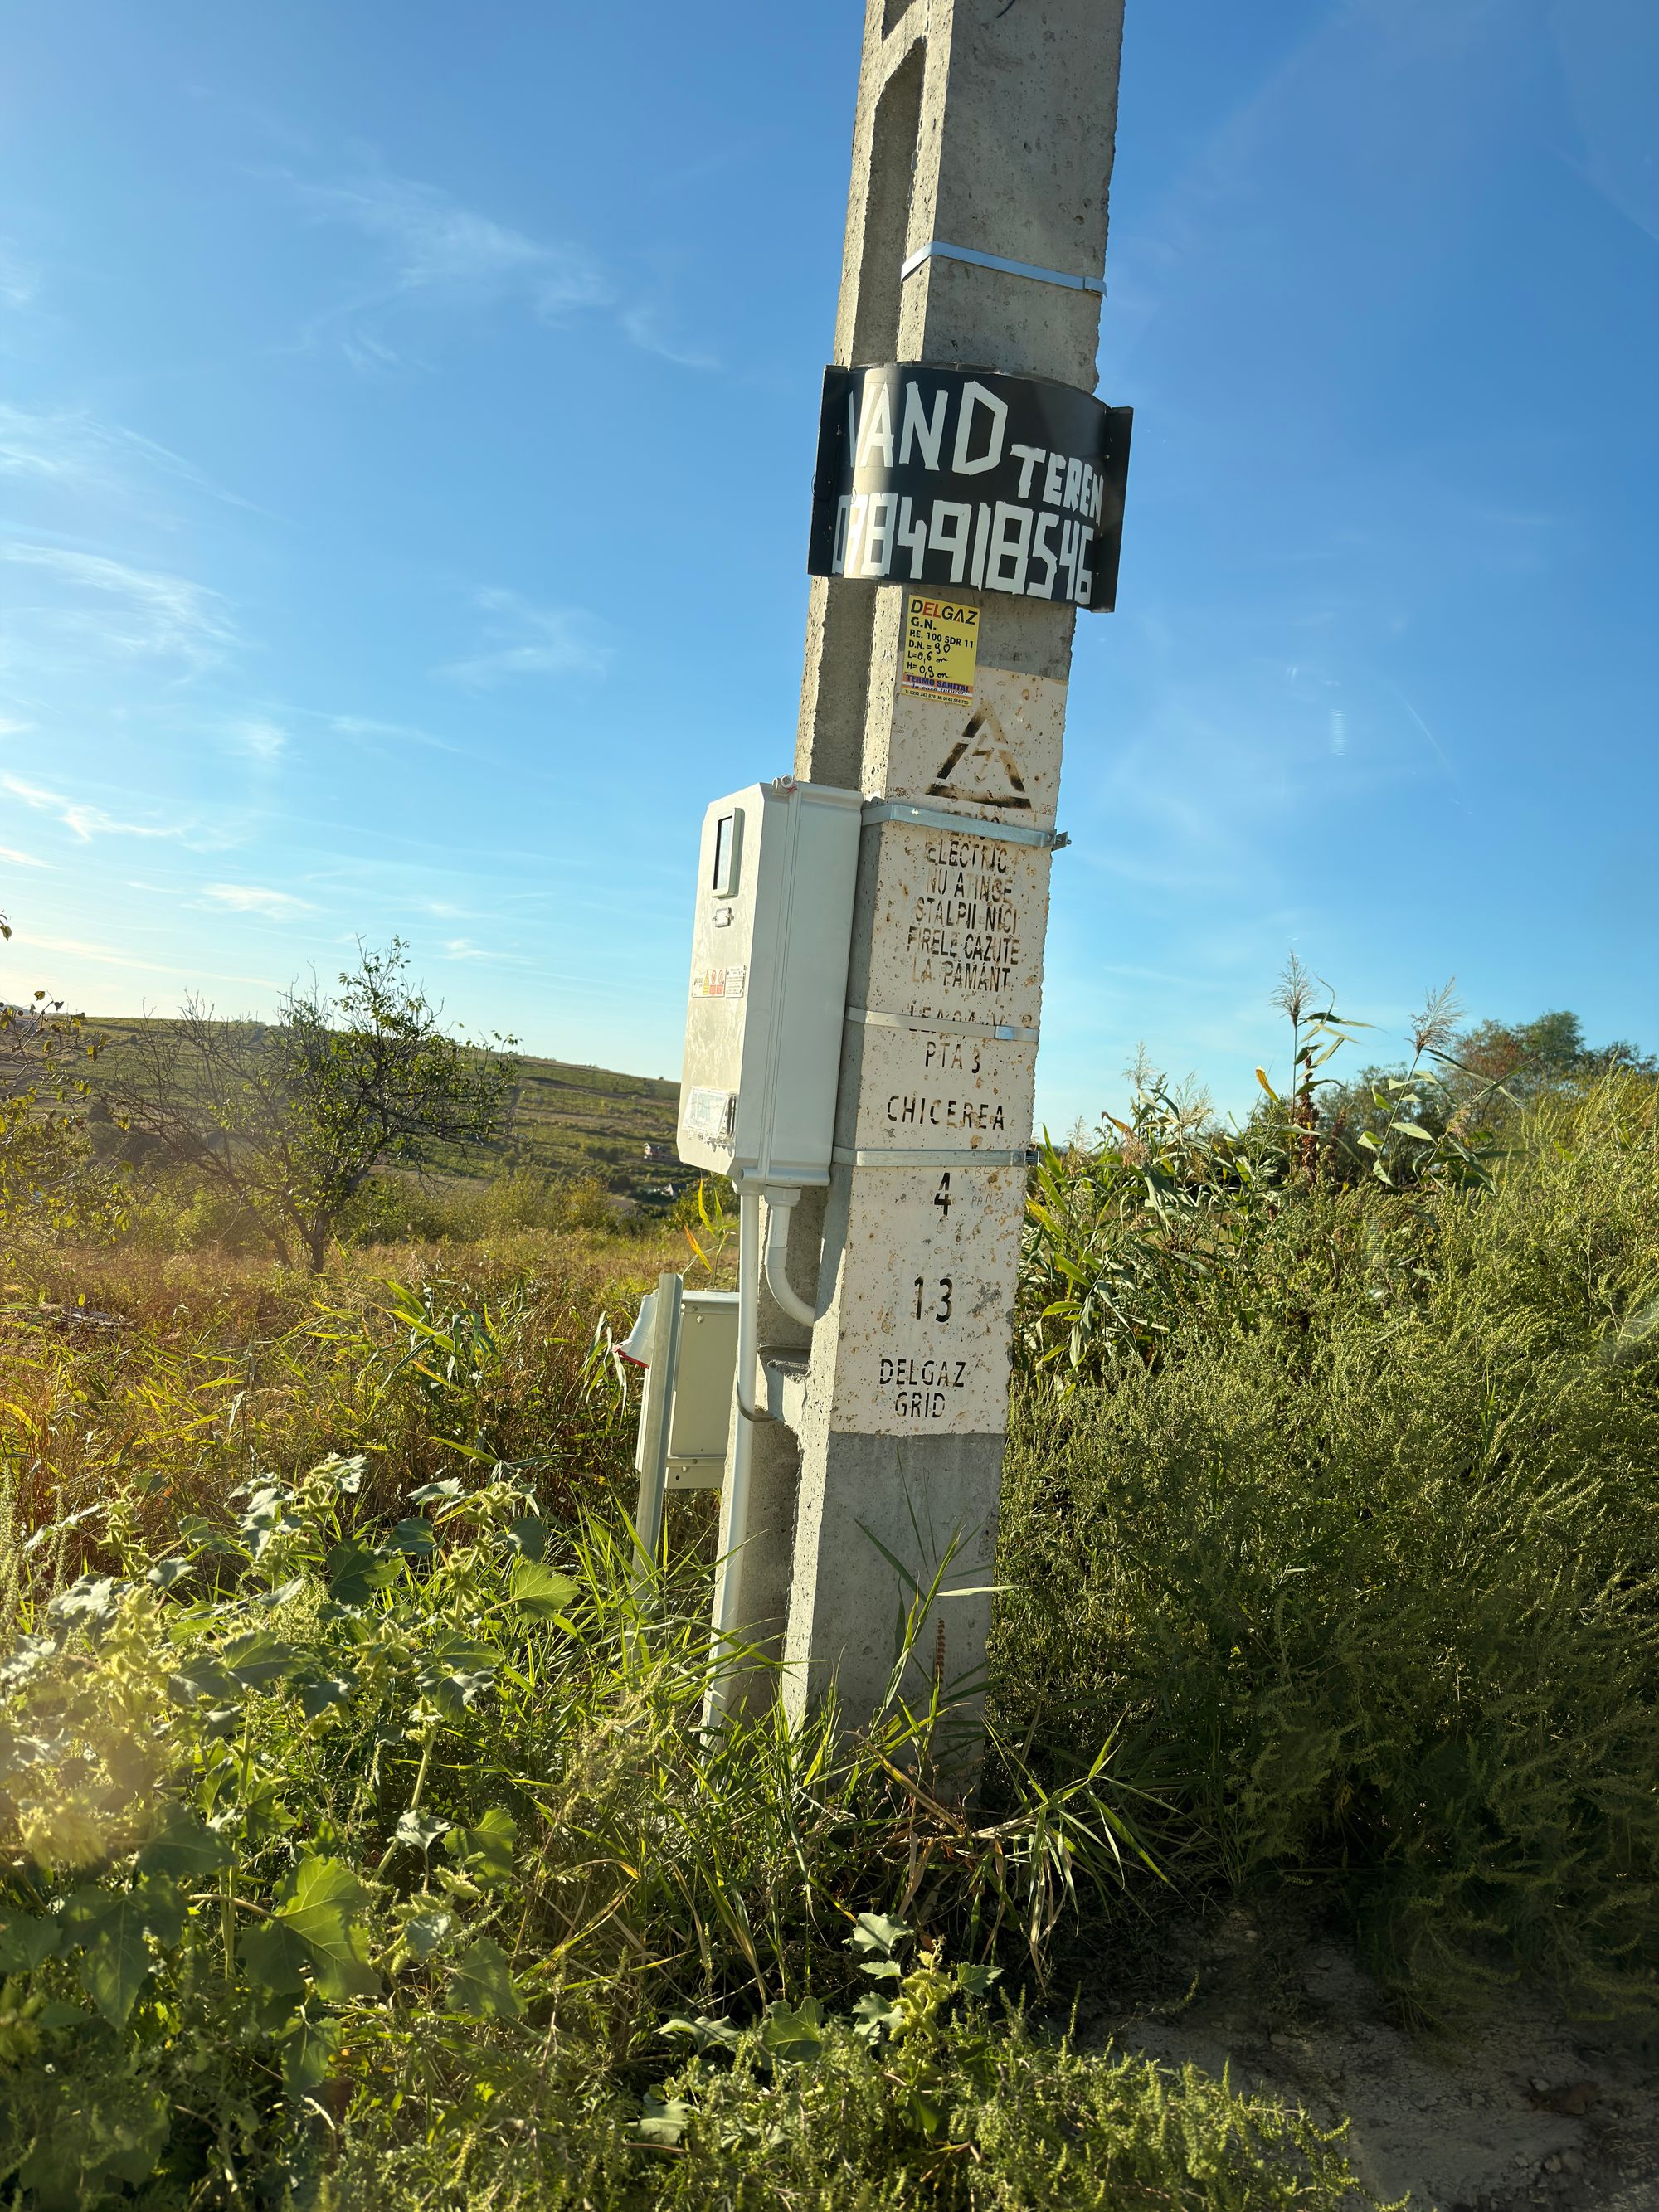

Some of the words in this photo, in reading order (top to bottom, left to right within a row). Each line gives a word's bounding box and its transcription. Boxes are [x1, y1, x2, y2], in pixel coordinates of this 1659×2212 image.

[848, 380, 1009, 476] VAND
[1010, 443, 1104, 527] TEREN
[832, 493, 1094, 605] 0784918546
[911, 599, 978, 625] DELGAZ
[911, 616, 937, 630] G.N.
[908, 639, 925, 650] D.N.
[910, 630, 923, 639] P.E.
[927, 632, 942, 642] 100
[945, 635, 961, 646] SDR
[965, 639, 973, 649] 11
[907, 674, 935, 686] TERMO
[925, 839, 1009, 874] ELECTRIC
[925, 1041, 963, 1070] PTA
[887, 1095, 1005, 1131] CHICEREA
[934, 1172, 953, 1216] 4
[914, 1276, 953, 1323] 13
[879, 1358, 967, 1388] DELGAZ
[894, 1391, 946, 1418] GRID
